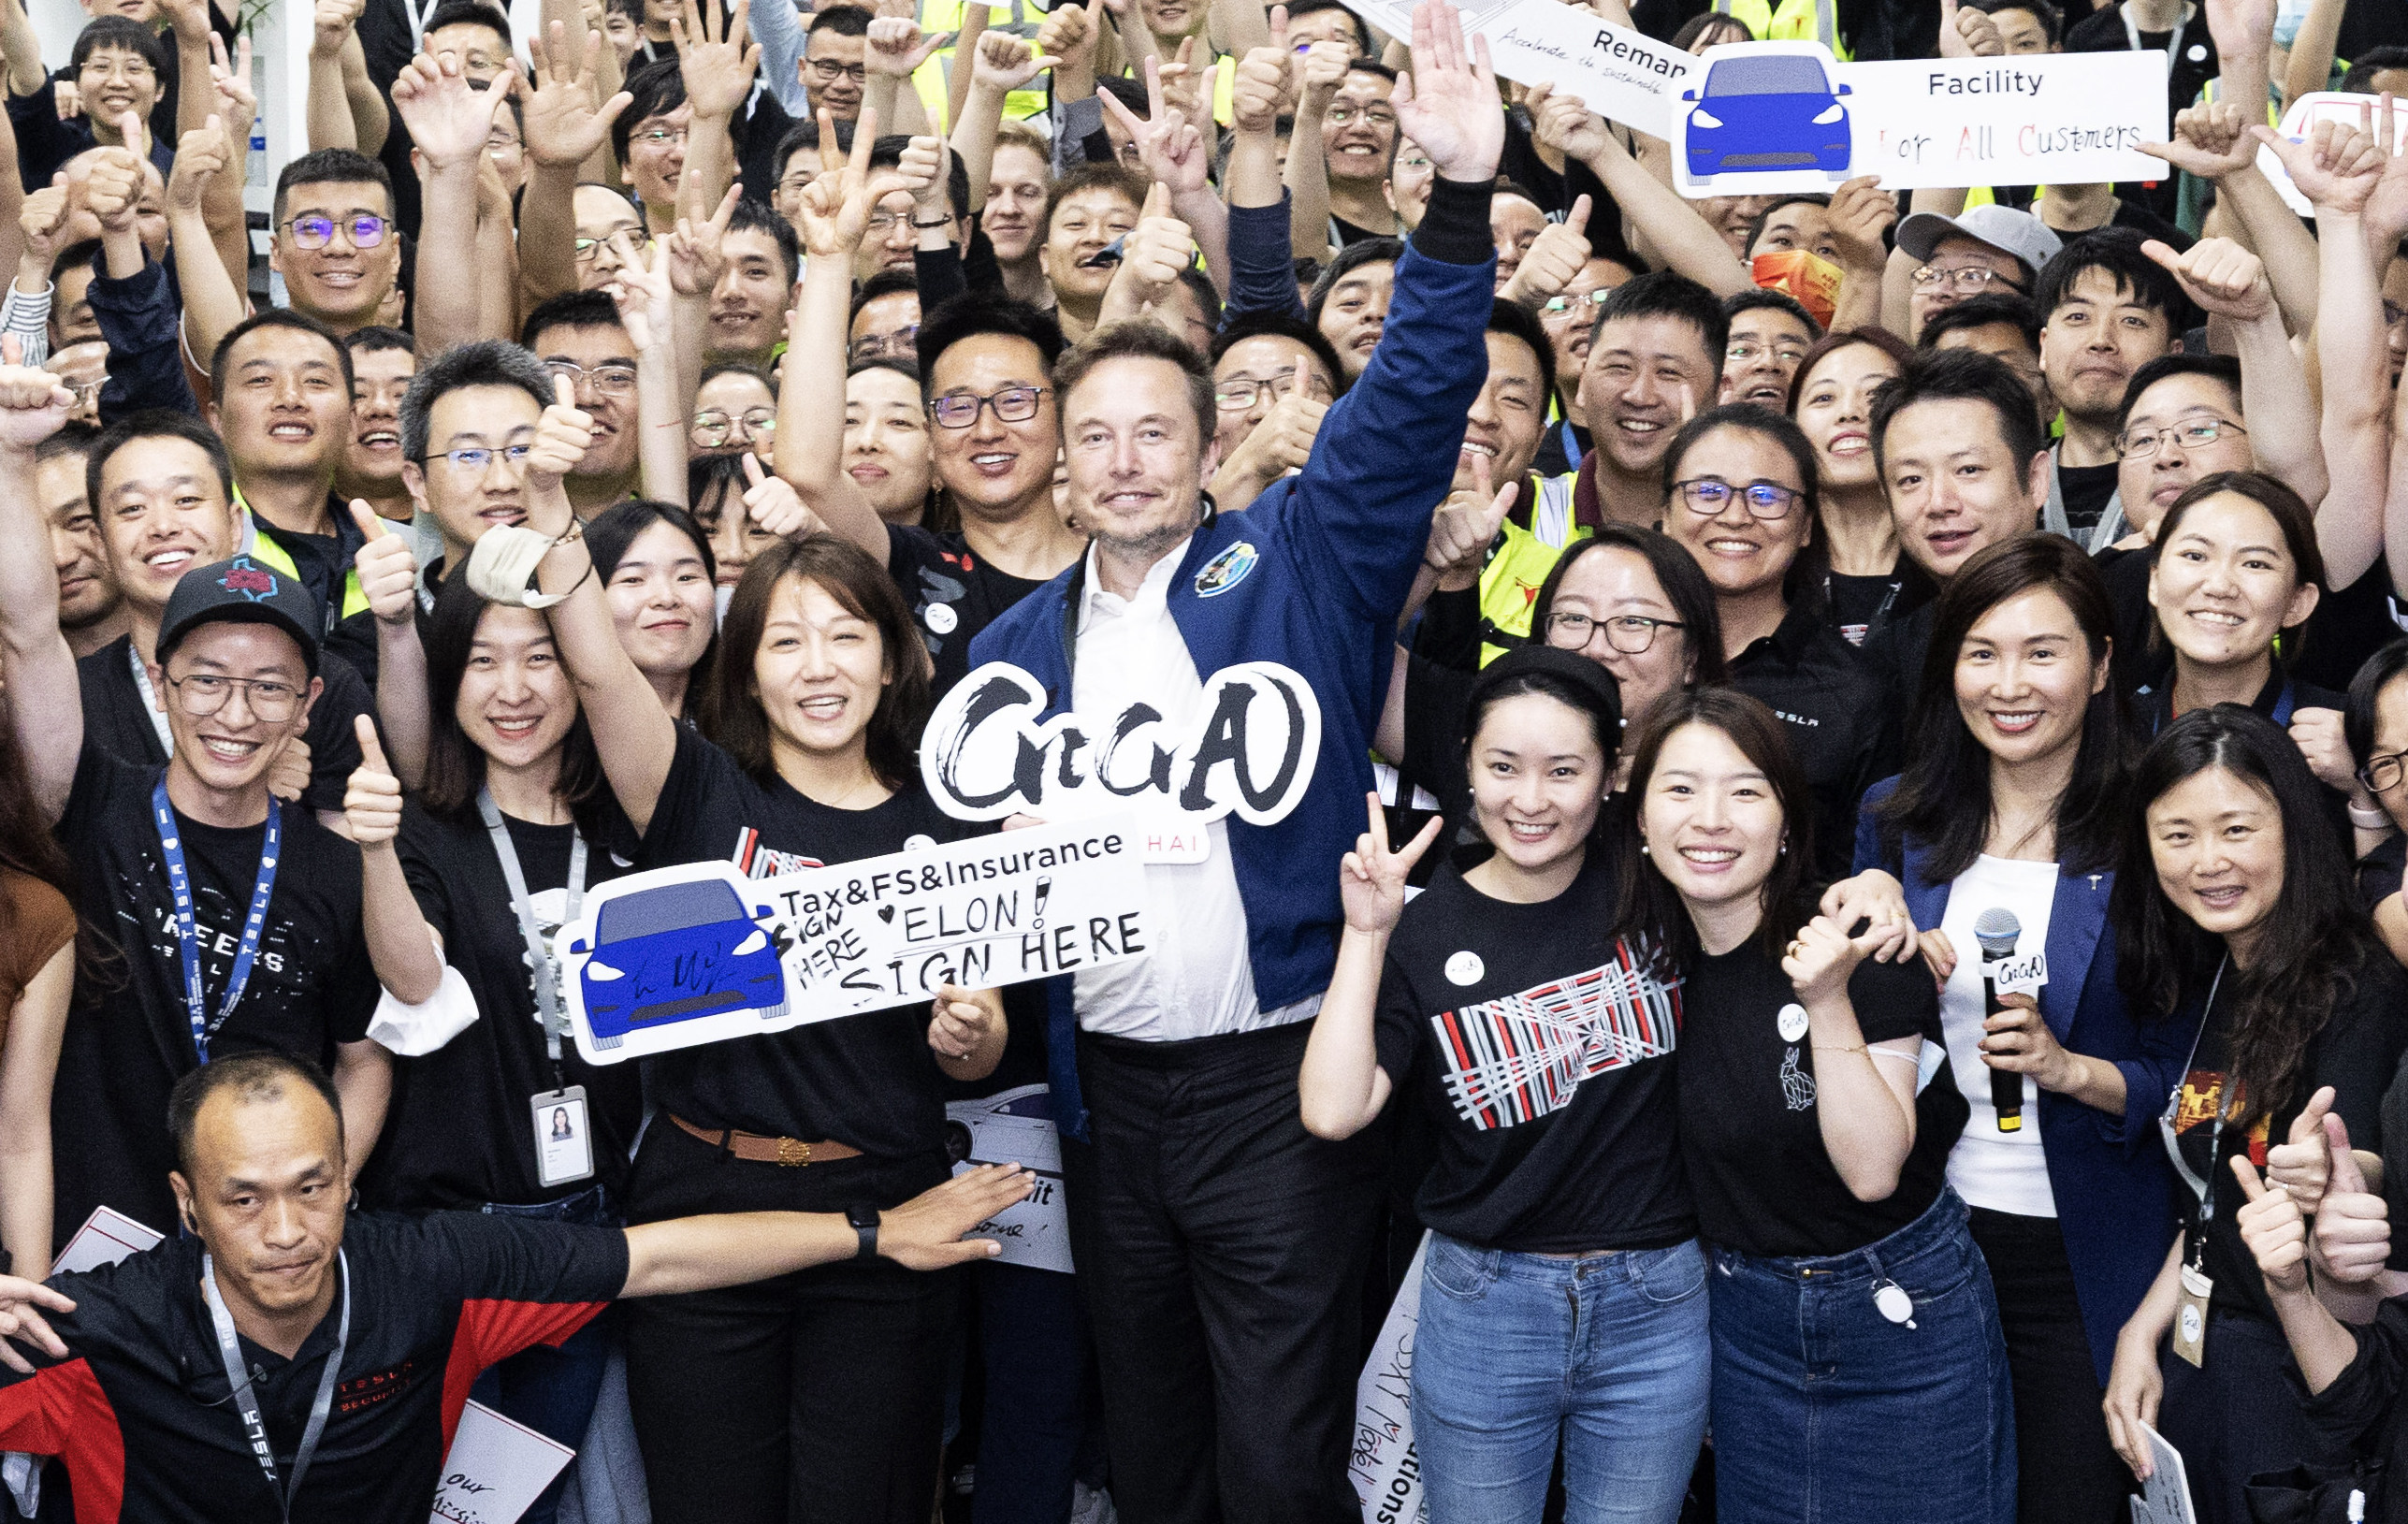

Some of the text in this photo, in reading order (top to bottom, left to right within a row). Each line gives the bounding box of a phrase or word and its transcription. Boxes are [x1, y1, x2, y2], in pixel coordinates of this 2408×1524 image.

[1929, 70, 2043, 95] Facility
[1957, 125, 1994, 160] All
[2018, 123, 2140, 156] Customers
[1775, 710, 1820, 727] ESLA
[1148, 835, 1197, 852] HAI
[170, 864, 193, 940] TESLA
[780, 834, 1123, 917] Tax&FS&Insurance
[240, 882, 269, 955] TESLA
[772, 909, 842, 959] SIGN
[792, 928, 867, 990] HERE
[840, 911, 1145, 1008] SIGN HERE
[244, 1410, 277, 1482] TESLA
